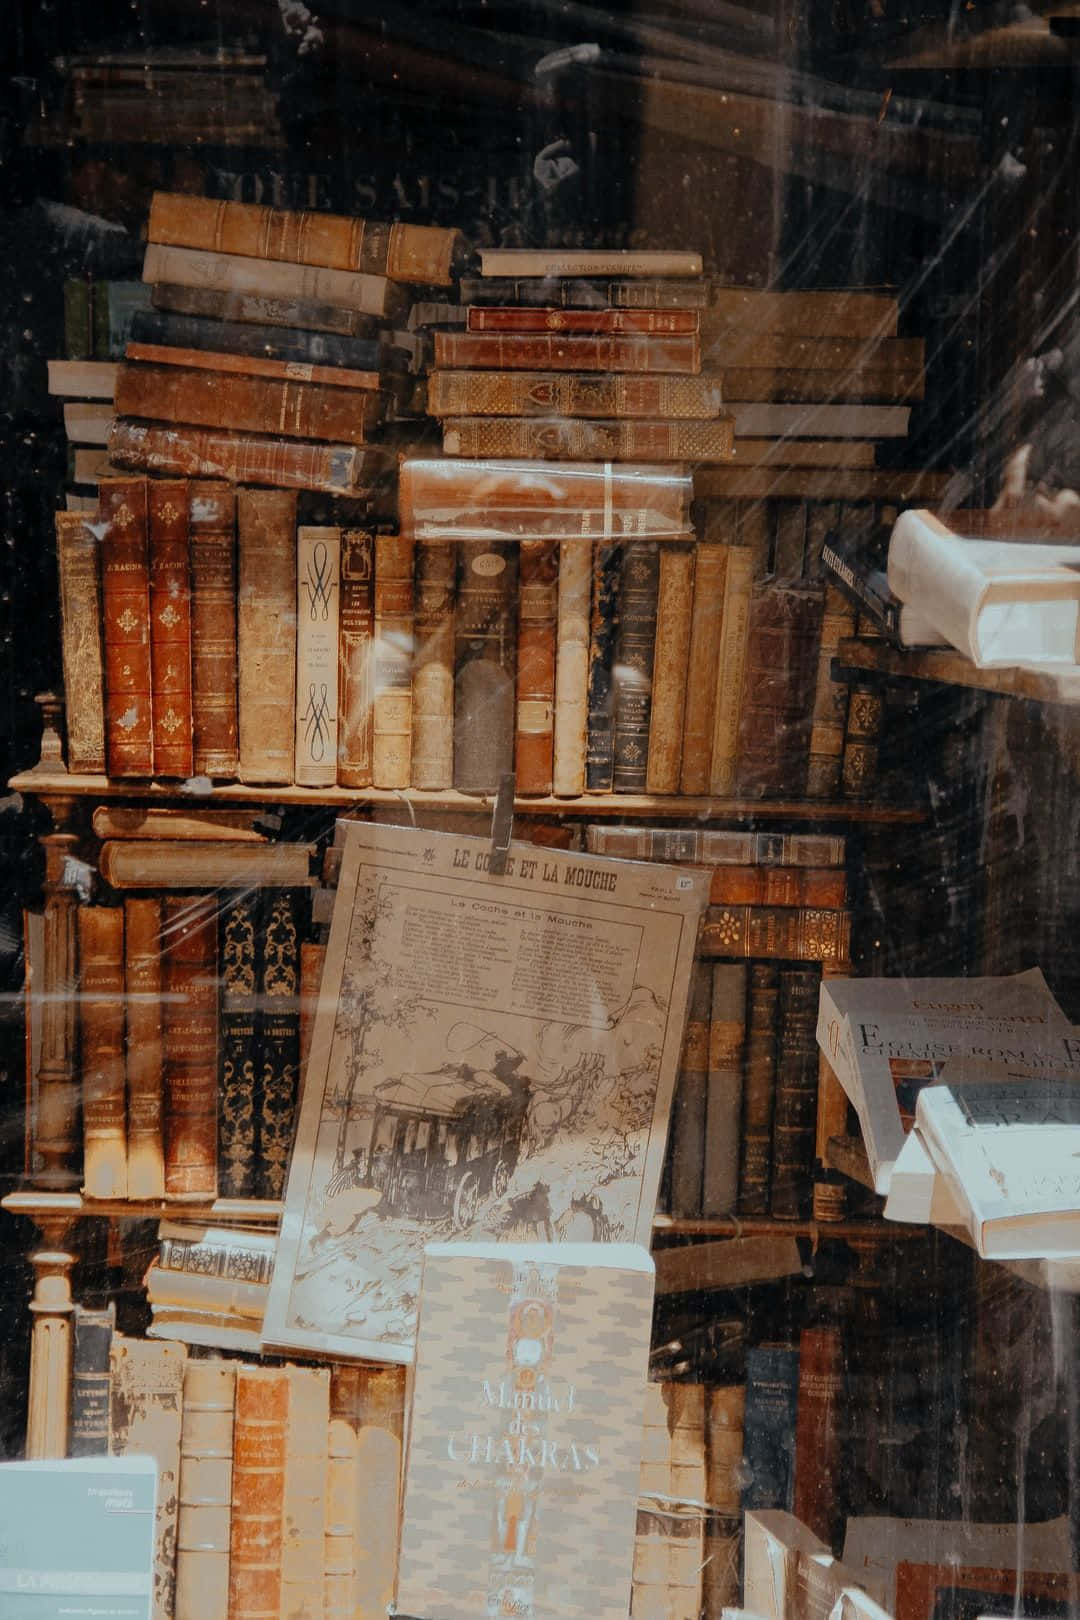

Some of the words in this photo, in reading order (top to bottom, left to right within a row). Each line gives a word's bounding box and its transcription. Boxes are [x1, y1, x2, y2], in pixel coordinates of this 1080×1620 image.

[452, 848, 472, 868] LE
[474, 853, 516, 876] COE
[519, 859, 538, 880] ET
[542, 863, 559, 883] LA
[564, 866, 618, 892] MOUCHE
